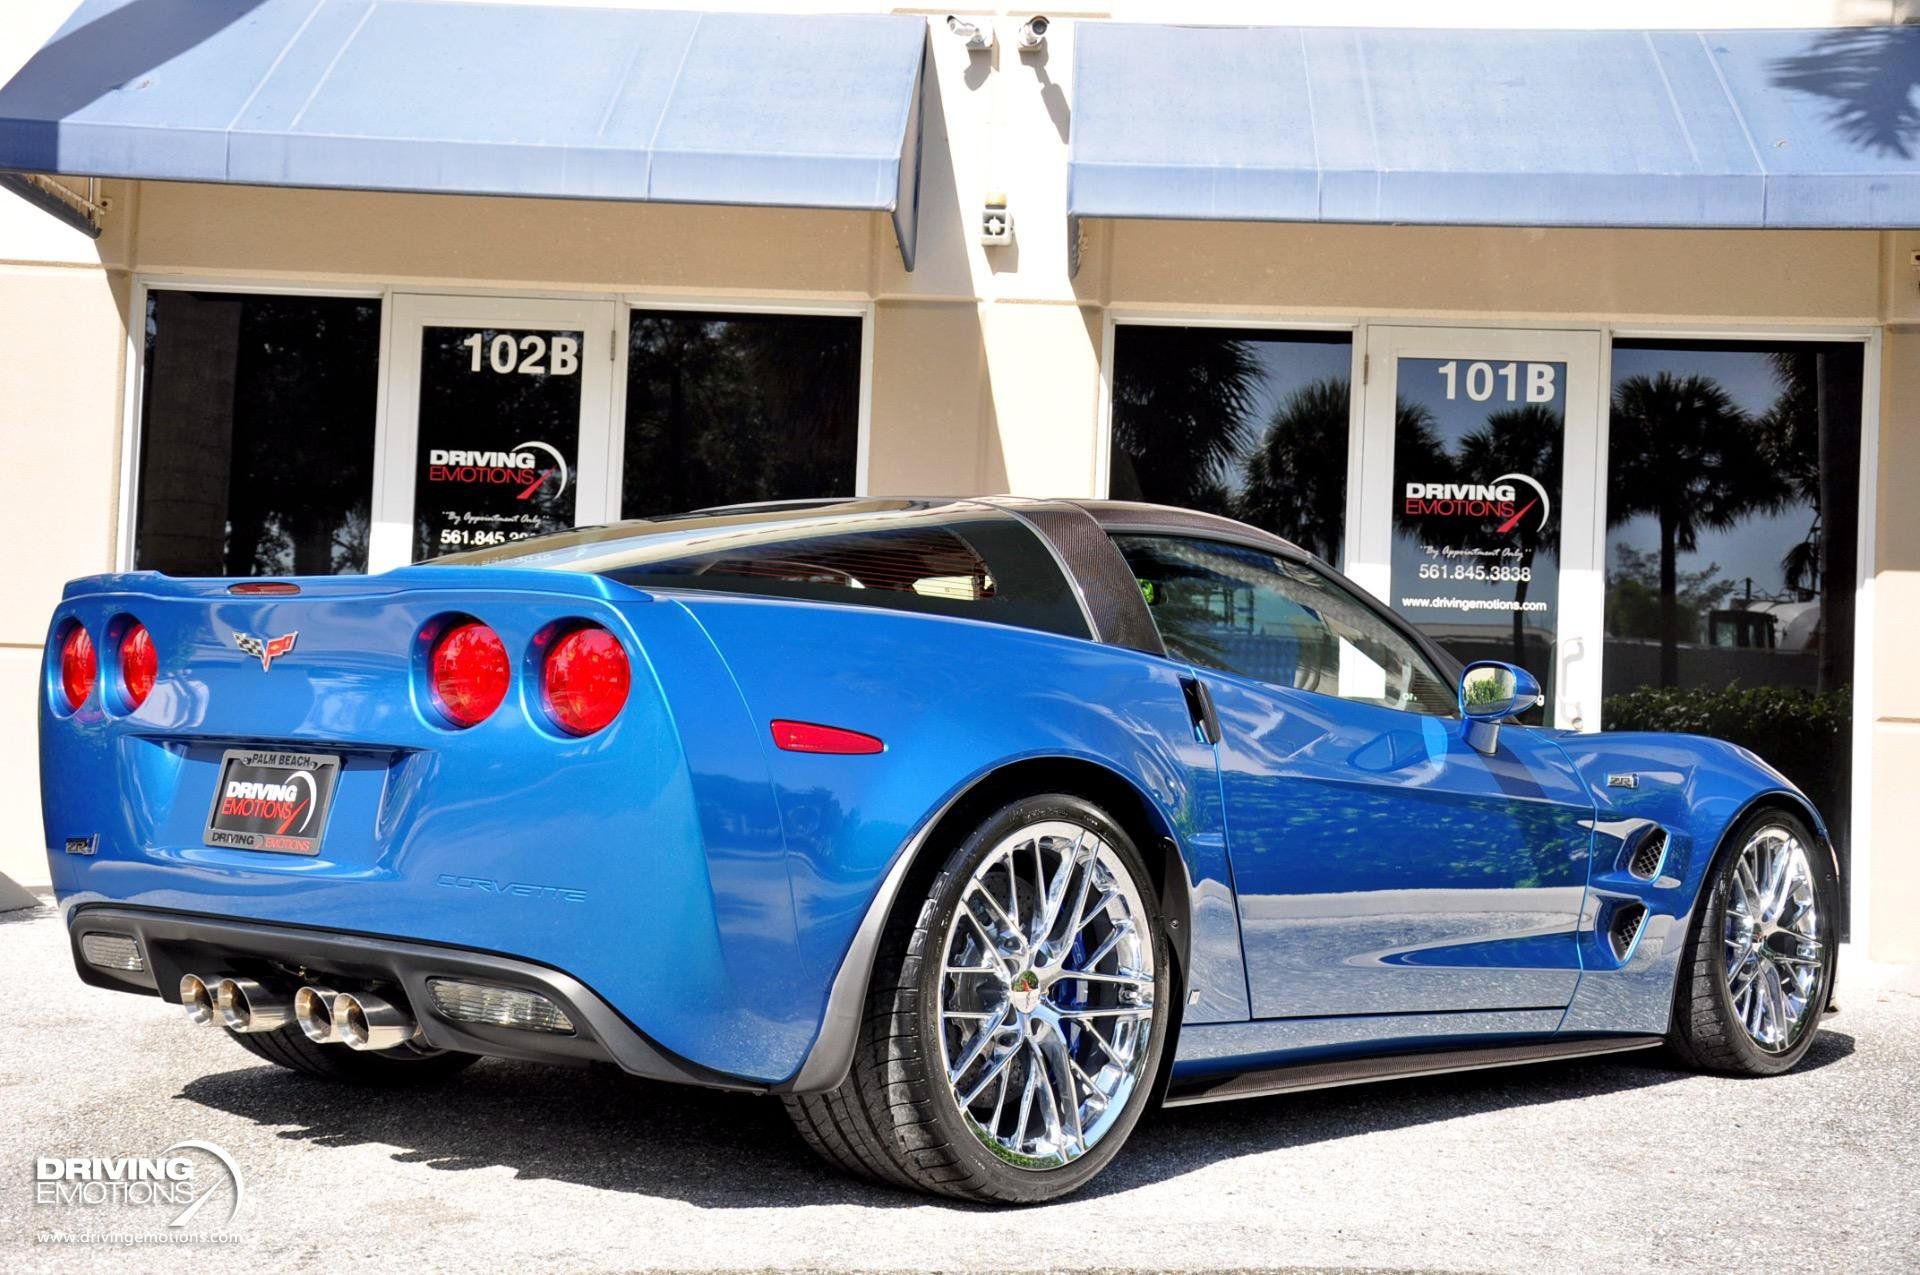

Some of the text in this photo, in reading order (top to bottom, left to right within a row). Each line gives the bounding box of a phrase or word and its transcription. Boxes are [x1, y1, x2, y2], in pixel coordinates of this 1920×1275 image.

[463, 333, 579, 376] 102B
[1438, 360, 1556, 403] 101B
[429, 449, 536, 469] DRIVING
[429, 465, 536, 485] EMOTIONS
[1405, 482, 1516, 502] DRIVING
[463, 511, 520, 525] Appointment
[1405, 499, 1516, 519] EMOTIONS
[1442, 545, 1500, 559] Appointment
[1418, 563, 1532, 582] 561.845.3838
[1402, 596, 1548, 612] www.drivingemotions.com
[251, 753, 312, 768] PALM BEACH
[225, 780, 298, 803] DRIVING
[221, 797, 294, 820] EMOTIONS
[211, 831, 311, 851] DRIVING EMOTIONS
[436, 872, 589, 904] CORVETTE
